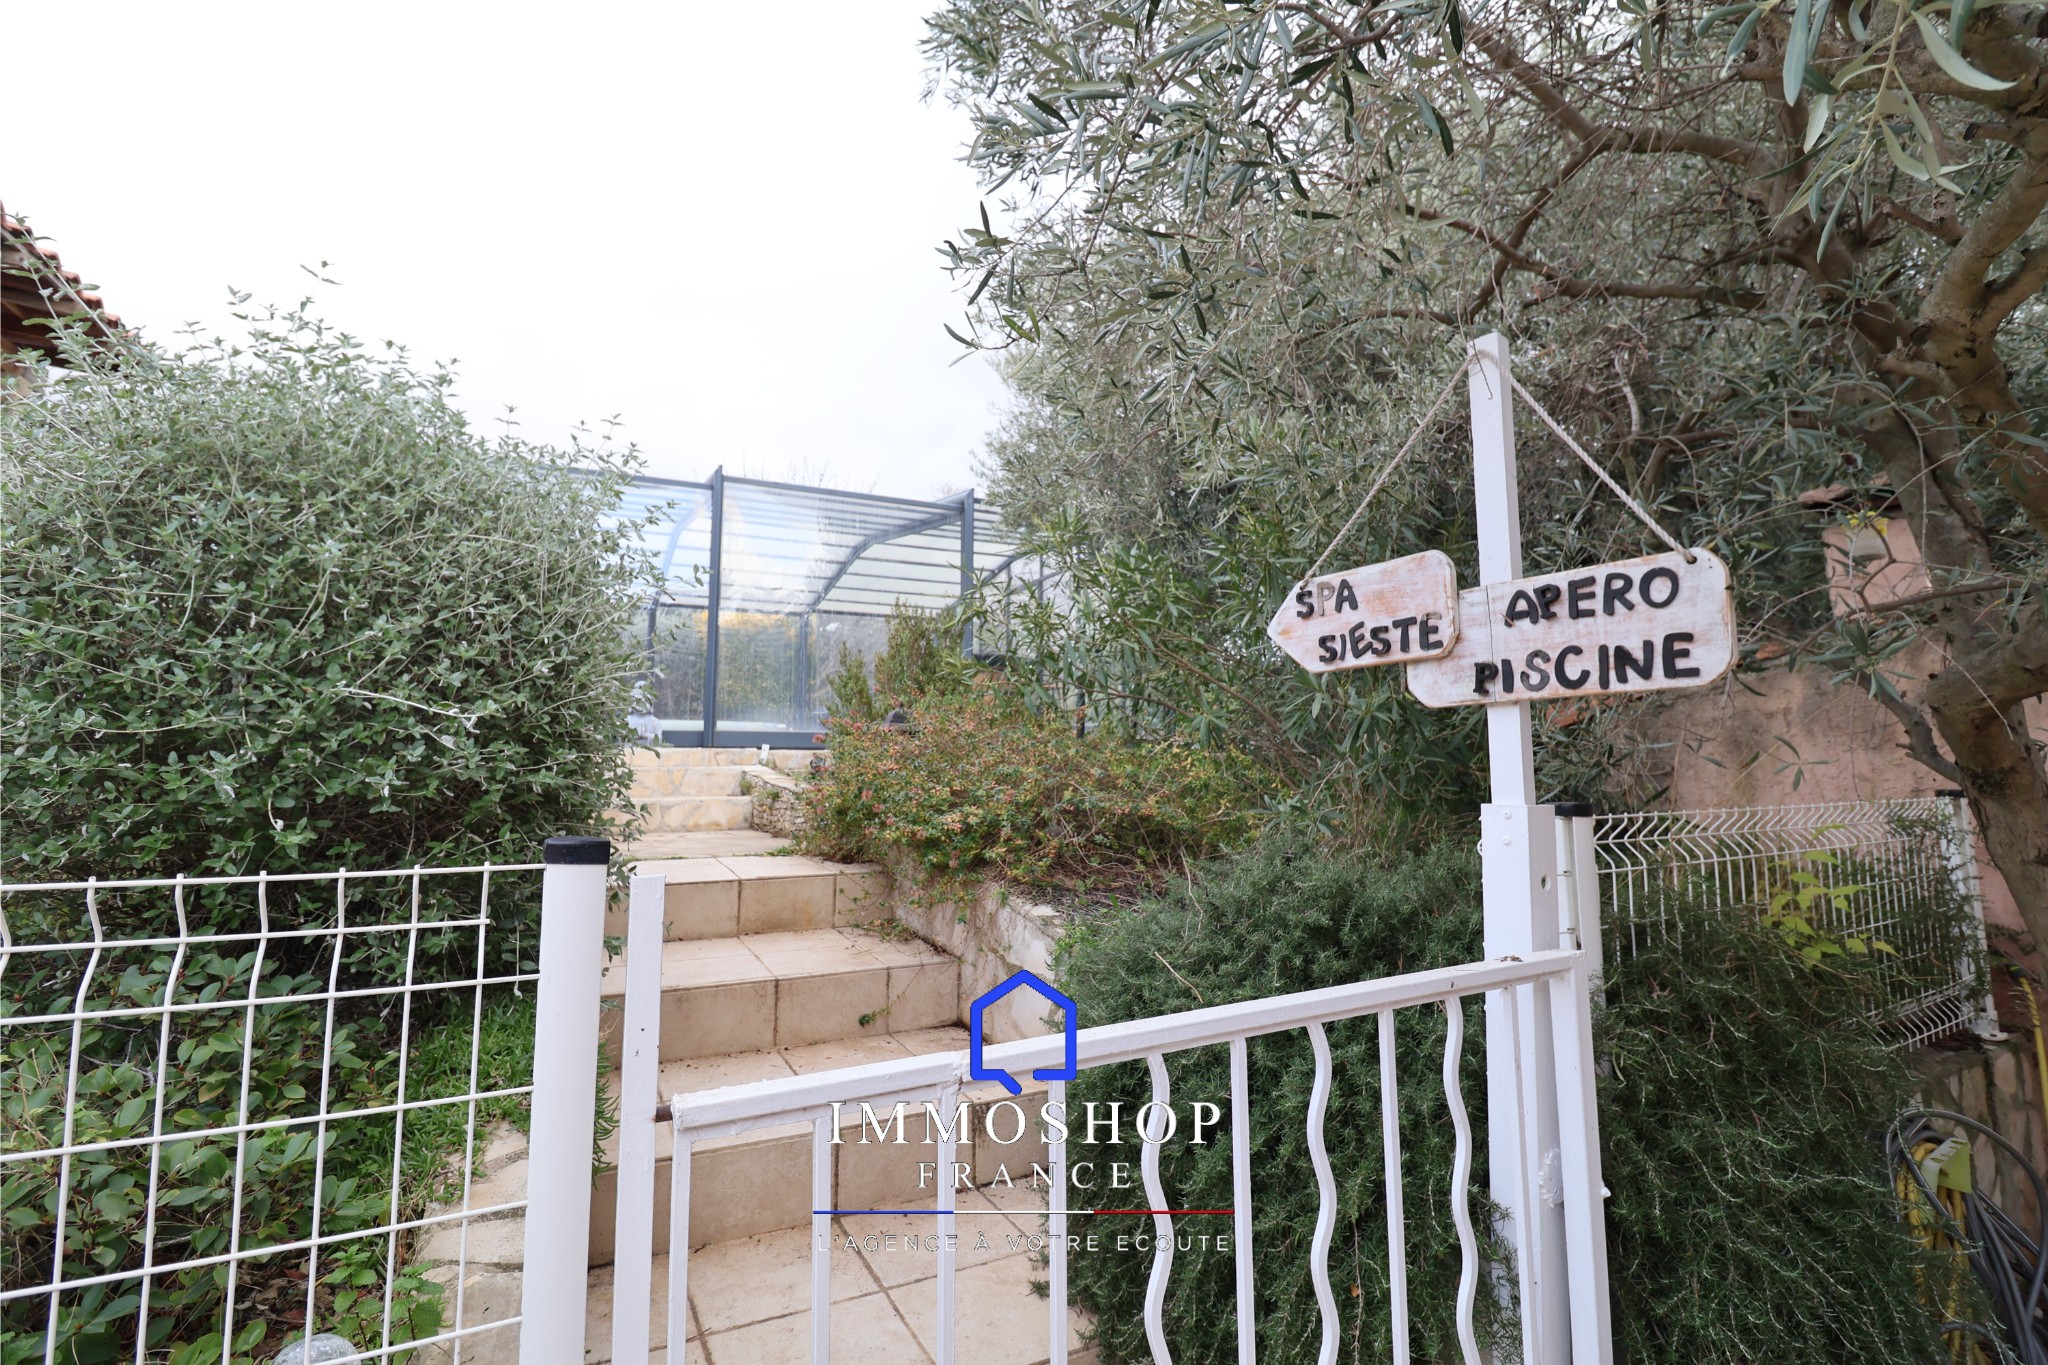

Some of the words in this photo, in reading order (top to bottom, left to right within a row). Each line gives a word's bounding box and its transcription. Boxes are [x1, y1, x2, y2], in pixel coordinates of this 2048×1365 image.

[1296, 578, 1359, 618] SPA
[1503, 567, 1680, 627] APERO
[1318, 612, 1444, 663] SIESTE
[1473, 632, 1701, 695] PISCINE
